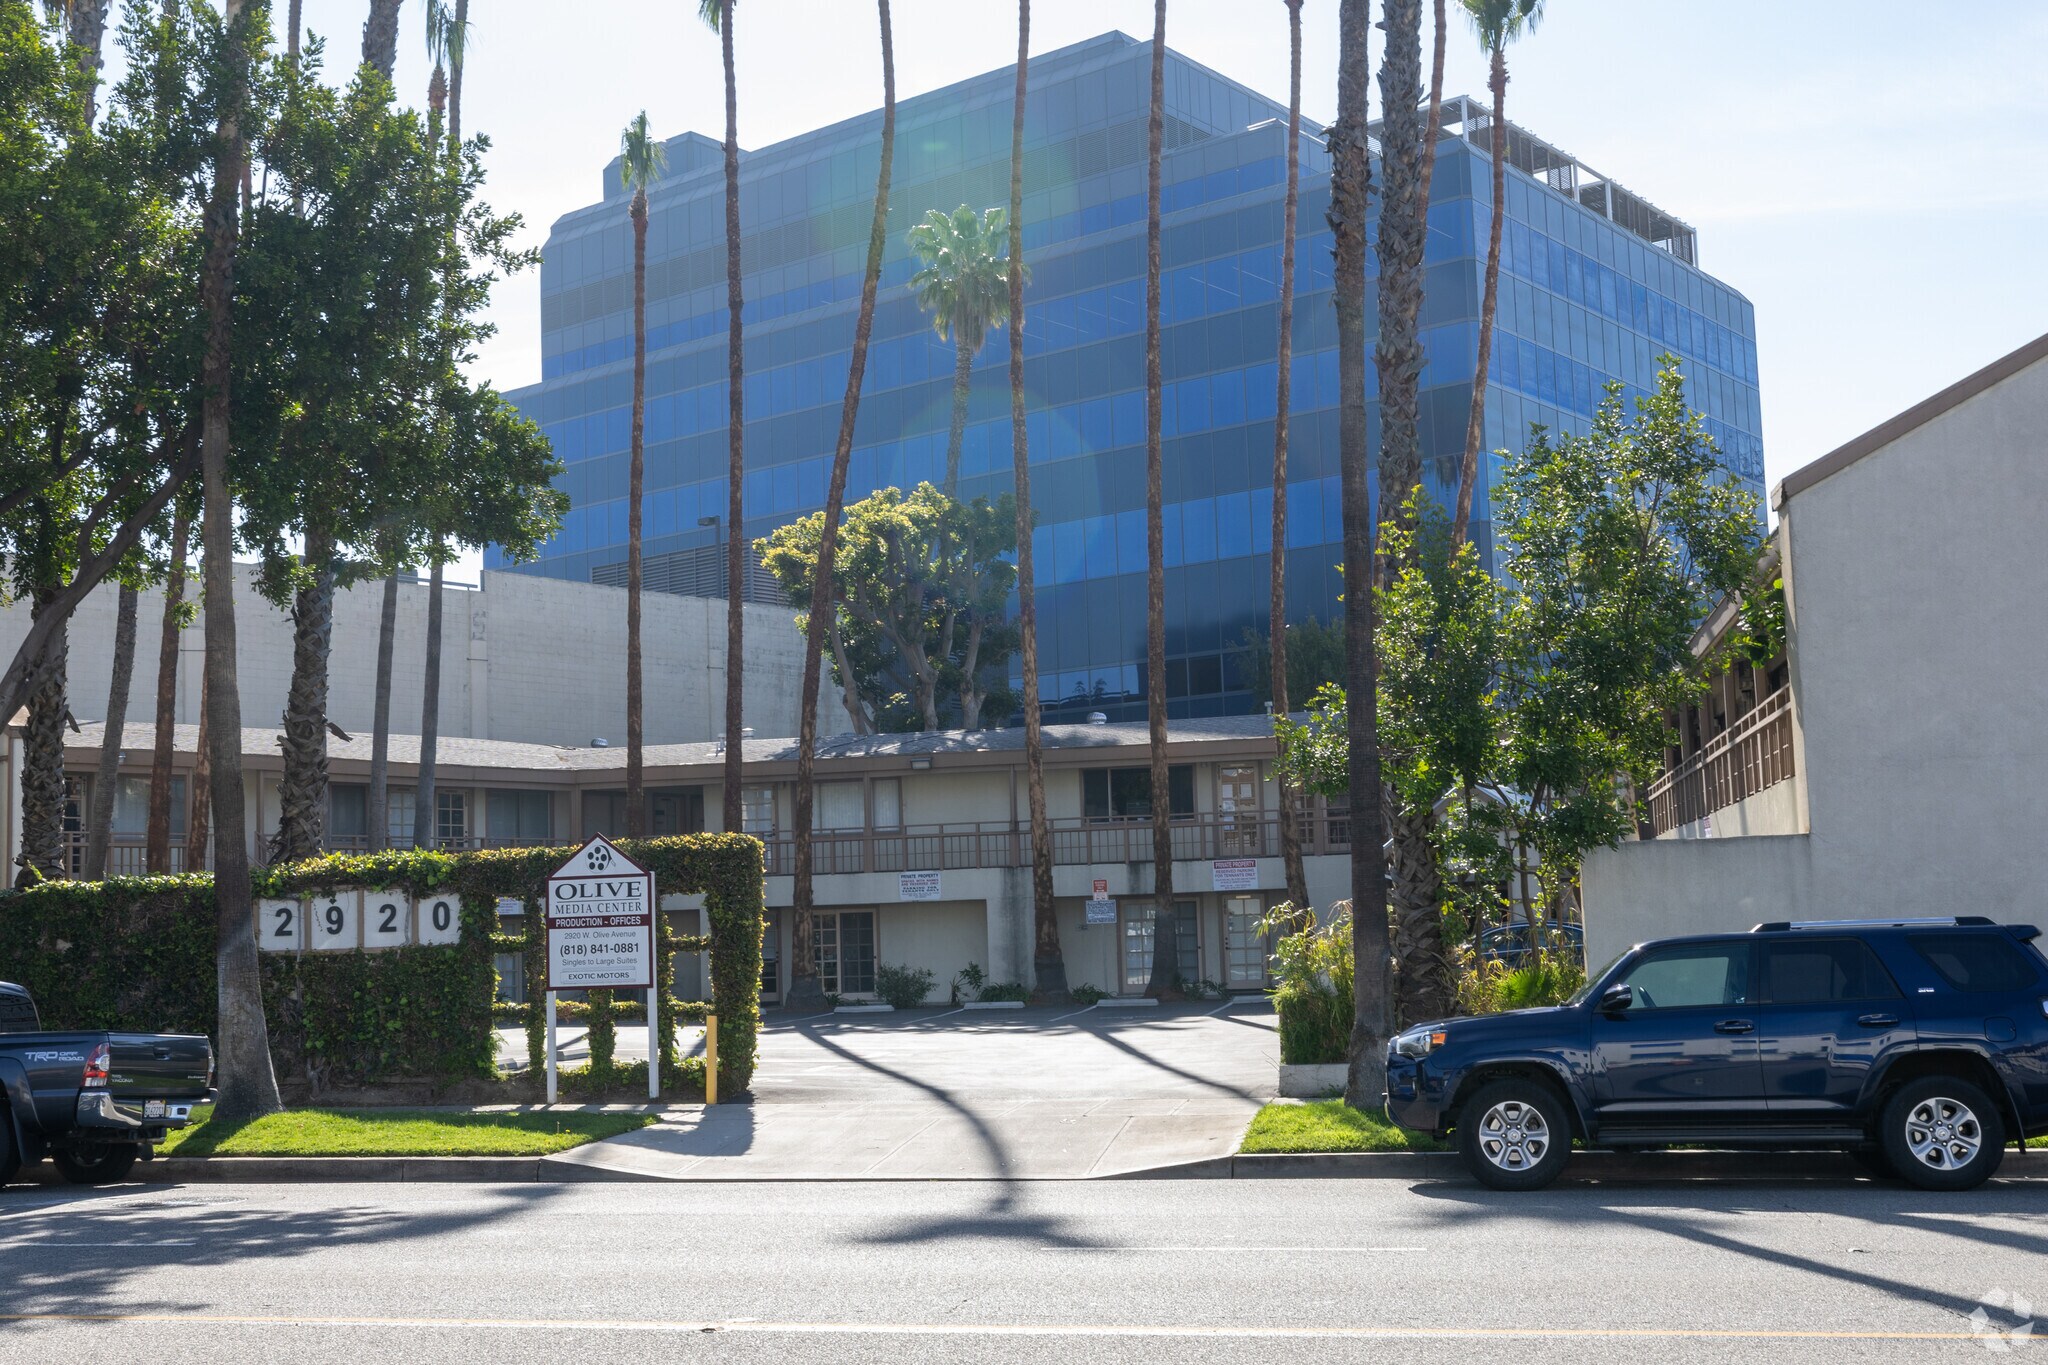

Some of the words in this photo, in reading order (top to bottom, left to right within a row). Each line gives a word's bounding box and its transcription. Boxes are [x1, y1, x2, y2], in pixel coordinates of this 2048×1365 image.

[555, 881, 642, 900] OLIVE
[555, 904, 592, 914] MEDIA
[597, 902, 642, 913] CENTER
[556, 917, 602, 927] PRODUCTION
[610, 916, 641, 926] OFFICES
[560, 944, 587, 957] (818)
[590, 943, 639, 954] 841-0881
[562, 959, 586, 967] Singles
[596, 958, 614, 966] Large
[25, 1051, 58, 1061] TRD
